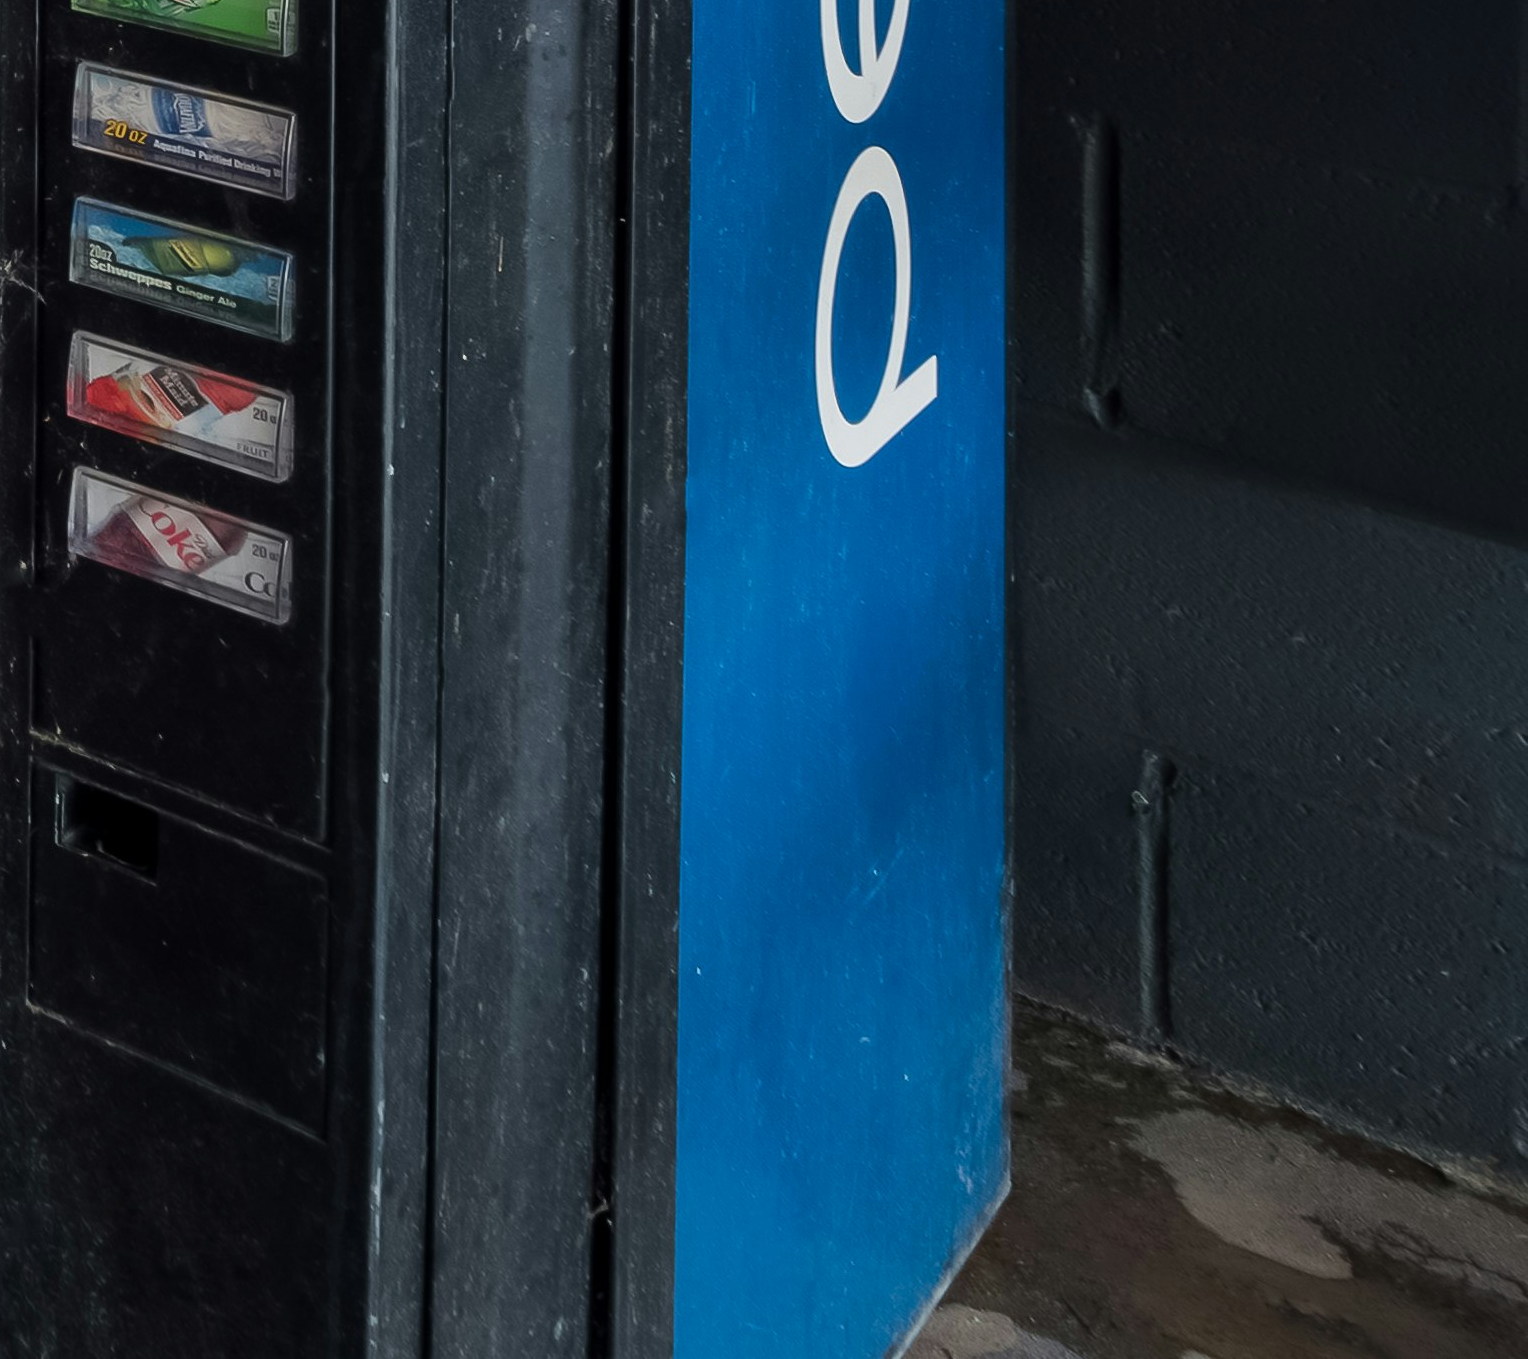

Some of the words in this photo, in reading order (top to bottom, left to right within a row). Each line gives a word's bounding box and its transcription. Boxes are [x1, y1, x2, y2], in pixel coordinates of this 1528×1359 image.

[103, 118, 128, 139] 20
[89, 259, 173, 291] Schweppes
[176, 285, 215, 303] Ginger
[218, 295, 237, 308] Ale
[252, 406, 268, 422] 20
[236, 442, 269, 458] FRUIT
[251, 543, 267, 559] 20
